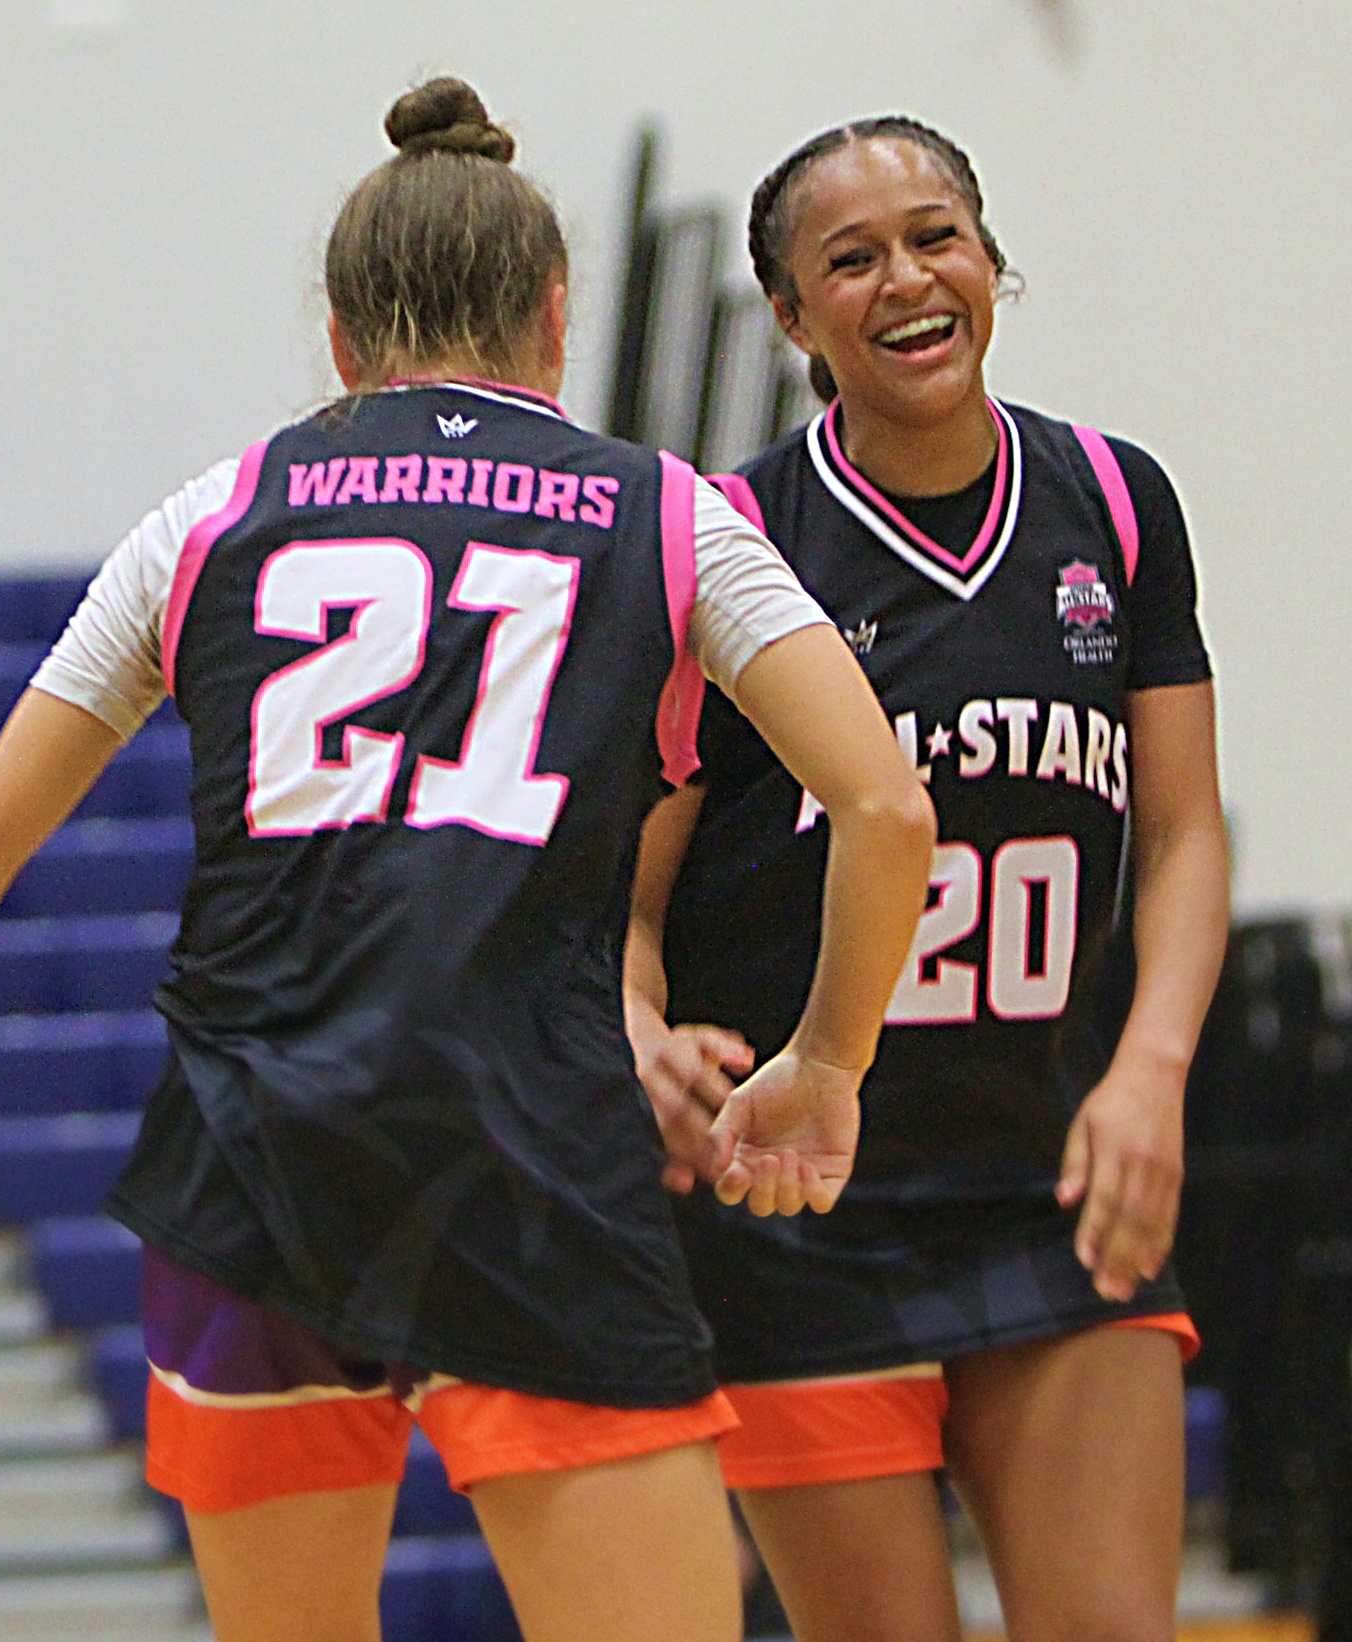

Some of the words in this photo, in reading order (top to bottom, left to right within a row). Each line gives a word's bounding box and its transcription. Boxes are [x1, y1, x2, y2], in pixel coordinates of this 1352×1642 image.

[288, 454, 620, 529] WARRIORS
[244, 537, 581, 847] 21
[959, 697, 1128, 813] STARS
[884, 836, 1080, 1026] 20
